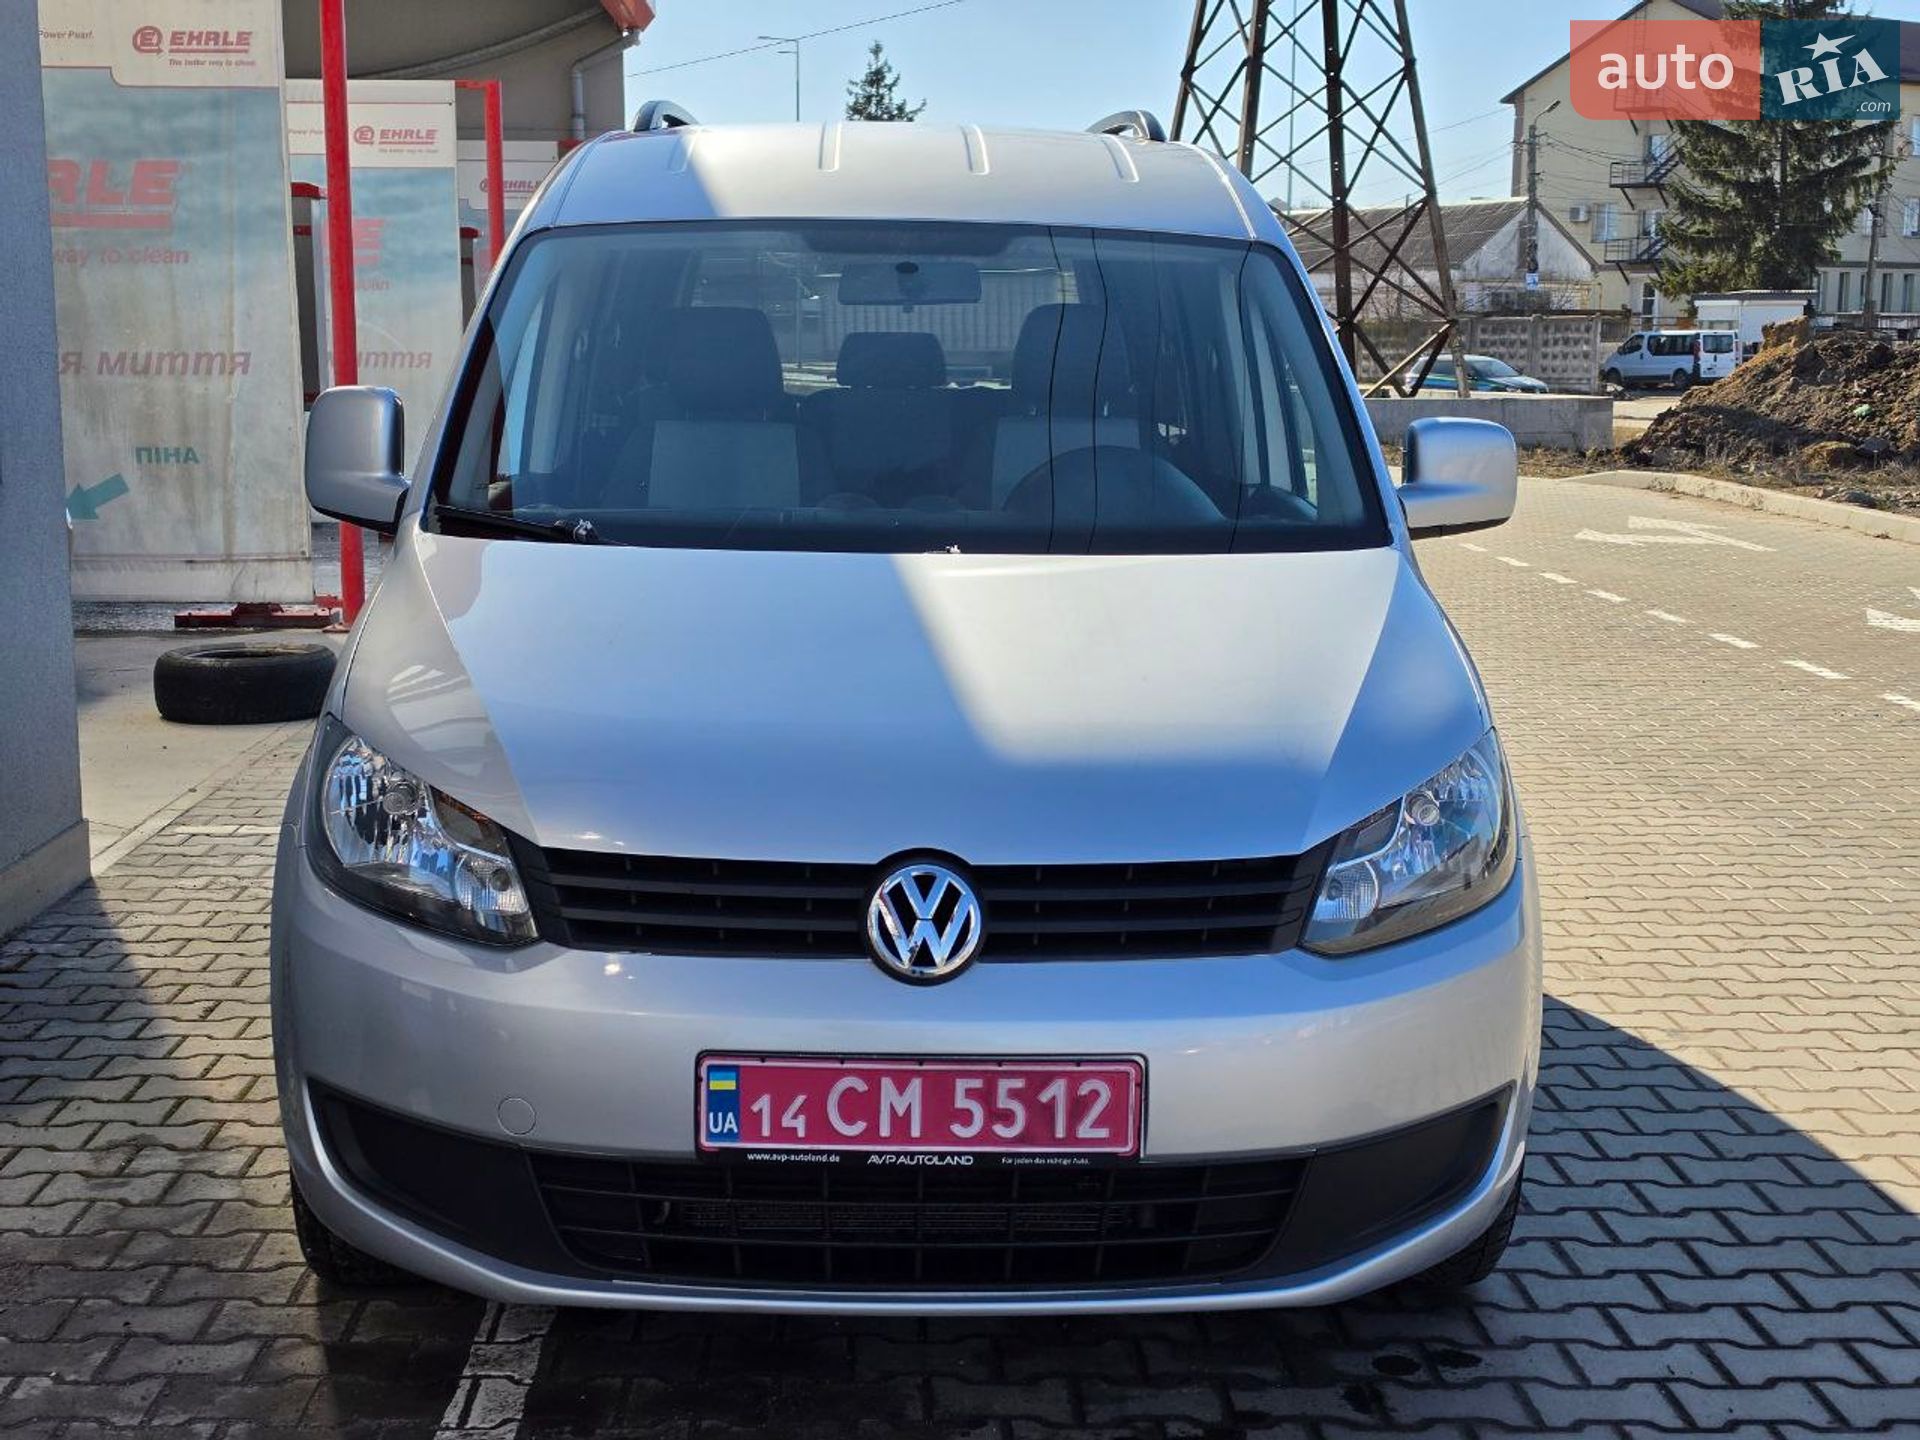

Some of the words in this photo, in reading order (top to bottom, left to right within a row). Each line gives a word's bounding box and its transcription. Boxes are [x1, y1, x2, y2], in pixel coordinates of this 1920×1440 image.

[169, 31, 253, 47] EHRLE
[380, 129, 438, 140] EHRLE
[97, 351, 252, 376] миття
[135, 447, 200, 465] ПІНА
[751, 1094, 808, 1138] 14
[827, 1076, 923, 1138] CM
[950, 1078, 1112, 1139] 5512
[709, 1112, 739, 1134] UA
[746, 1152, 840, 1163] www.avp-autoland.de
